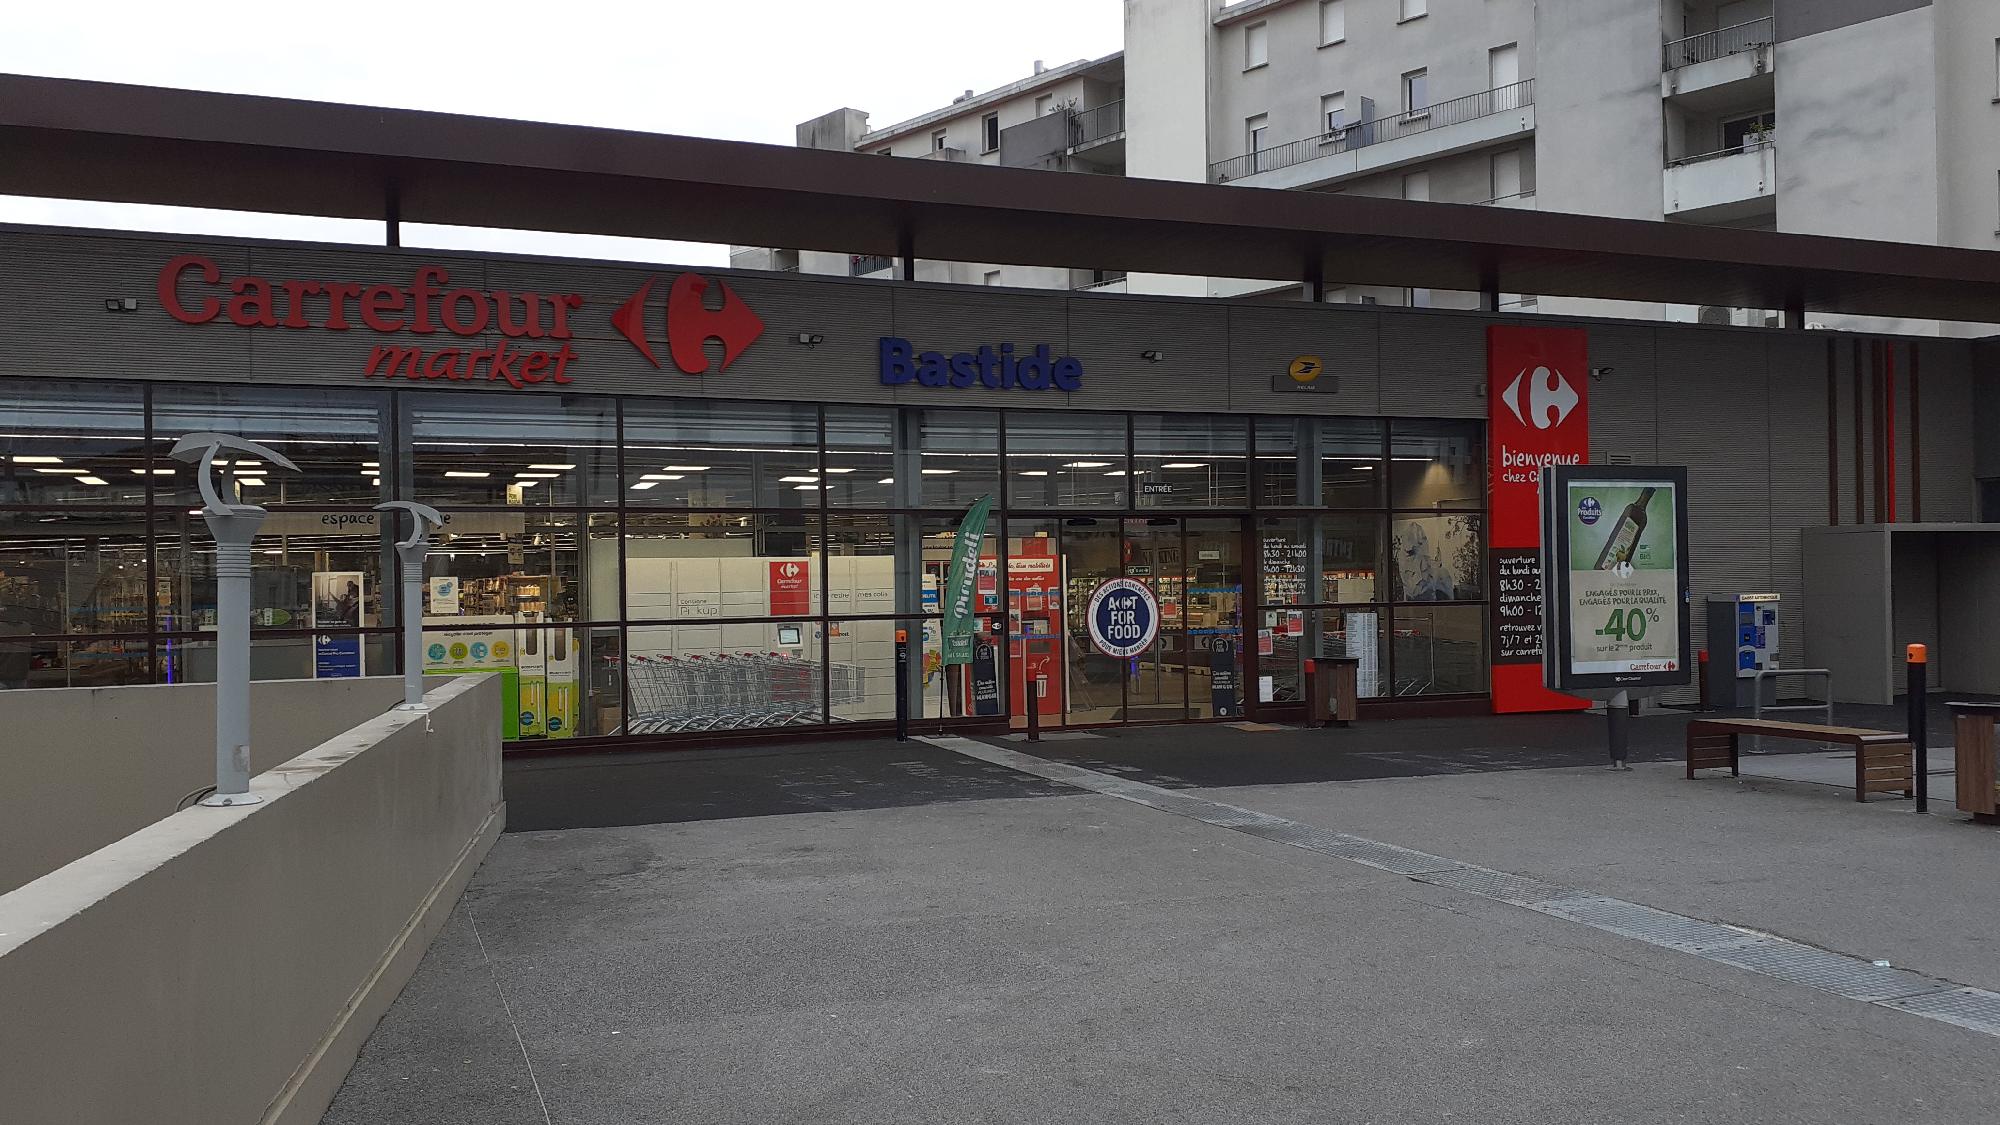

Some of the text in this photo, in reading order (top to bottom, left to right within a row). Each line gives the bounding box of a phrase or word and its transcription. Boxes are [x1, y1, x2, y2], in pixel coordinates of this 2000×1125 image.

[157, 253, 582, 339] Carrefour
[363, 340, 579, 389] market
[880, 336, 1083, 394] Bastide
[1502, 444, 1580, 468] bienvenue
[1502, 468, 1527, 483] chez
[1144, 484, 1173, 493] ENTRÉE
[1577, 508, 1602, 516] Produits
[321, 513, 375, 530] espace
[1263, 549, 1280, 558] 8h30
[1286, 549, 1307, 557] 21h00
[1499, 556, 1536, 564] ouverture
[1500, 565, 1511, 575] du
[1512, 565, 1530, 575] lundi
[1500, 578, 1524, 591] 8h30
[1500, 592, 1542, 602] dimanche
[1585, 588, 1618, 597] ENGAGÉS
[1619, 589, 1635, 597] POUR
[1612, 597, 1630, 605] POUR
[681, 606, 719, 616] Pikup
[1500, 605, 1524, 616] 9h00
[1110, 611, 1136, 626] FOR
[1107, 624, 1141, 640] FOOD
[1500, 623, 1535, 632] retrouvez
[1500, 634, 1520, 648] 7j/7
[1524, 635, 1532, 644] et
[1112, 647, 1130, 656] MIEX
[1501, 644, 1542, 657] sur carrefo
[1629, 642, 1652, 653] produit
[1630, 662, 1662, 671] Carrefour
